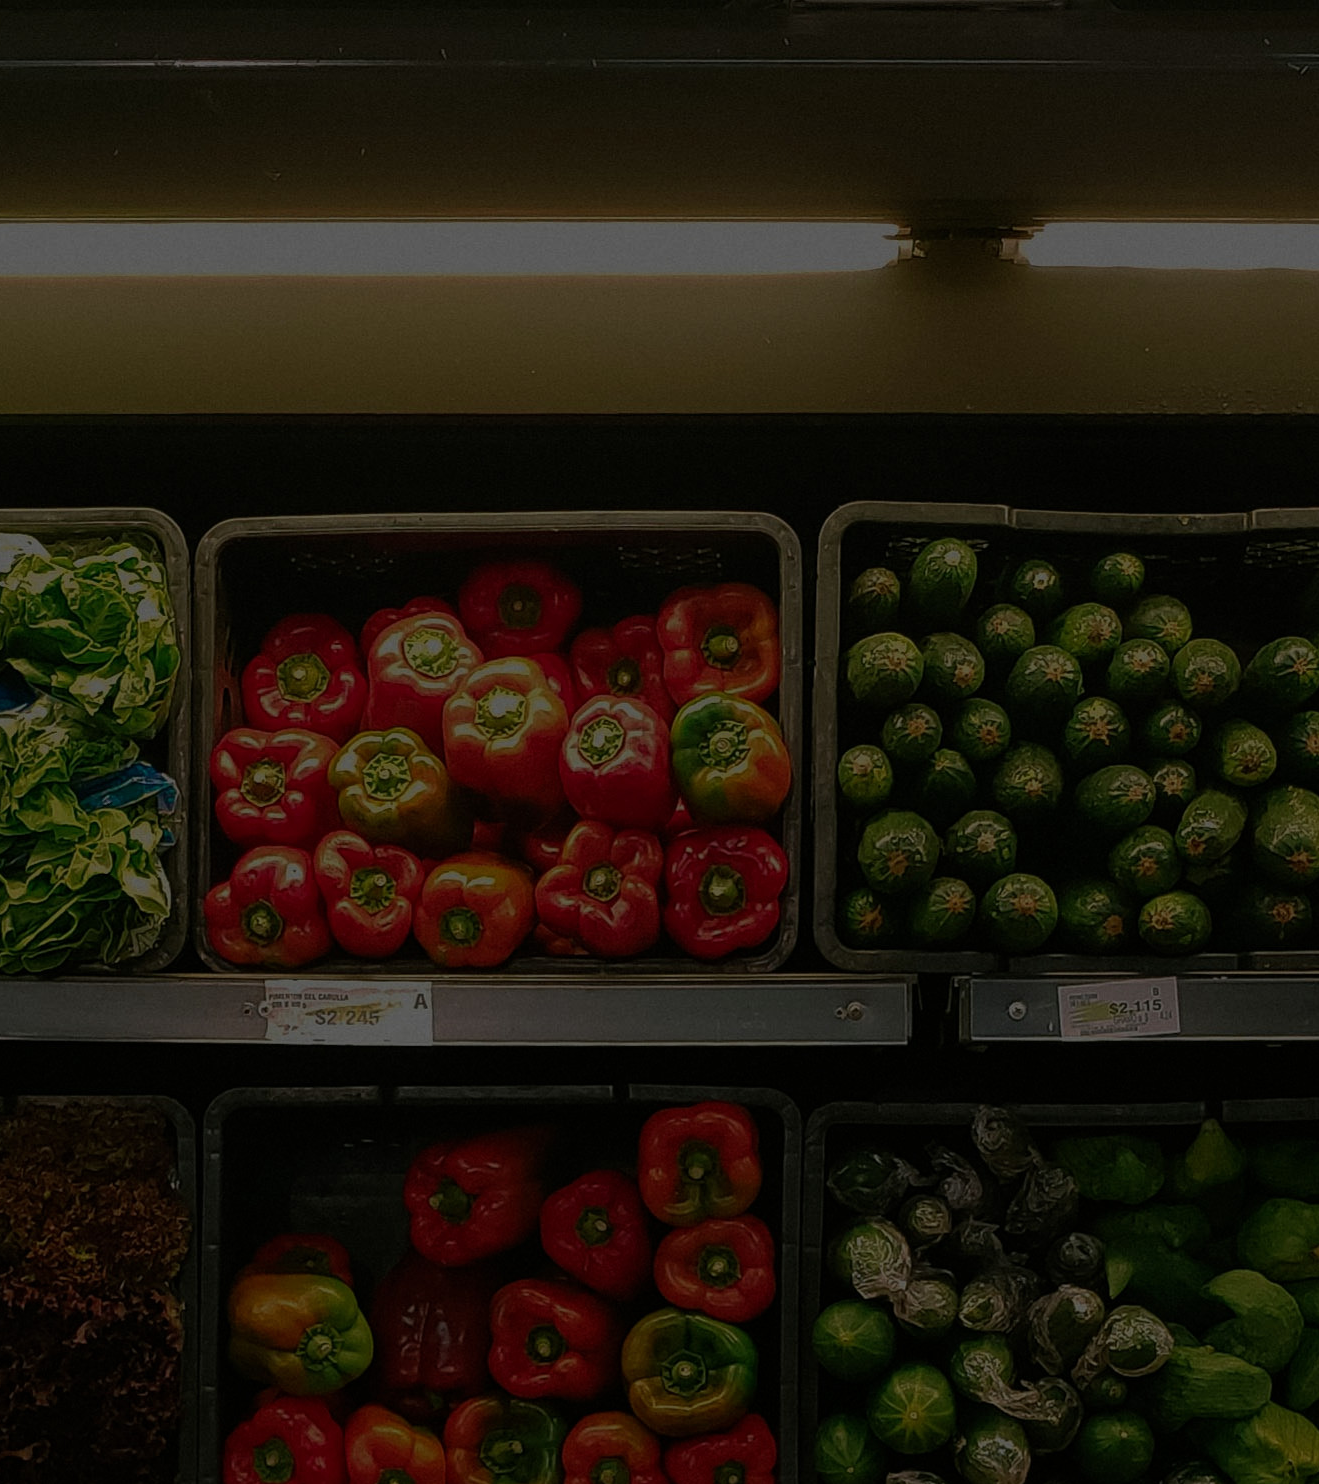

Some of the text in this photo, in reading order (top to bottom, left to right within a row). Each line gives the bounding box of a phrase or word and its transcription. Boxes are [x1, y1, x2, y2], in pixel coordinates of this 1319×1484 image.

[414, 993, 428, 1009] A
[1109, 1000, 1161, 1015] $2,115
[315, 1010, 380, 1026] $2245
